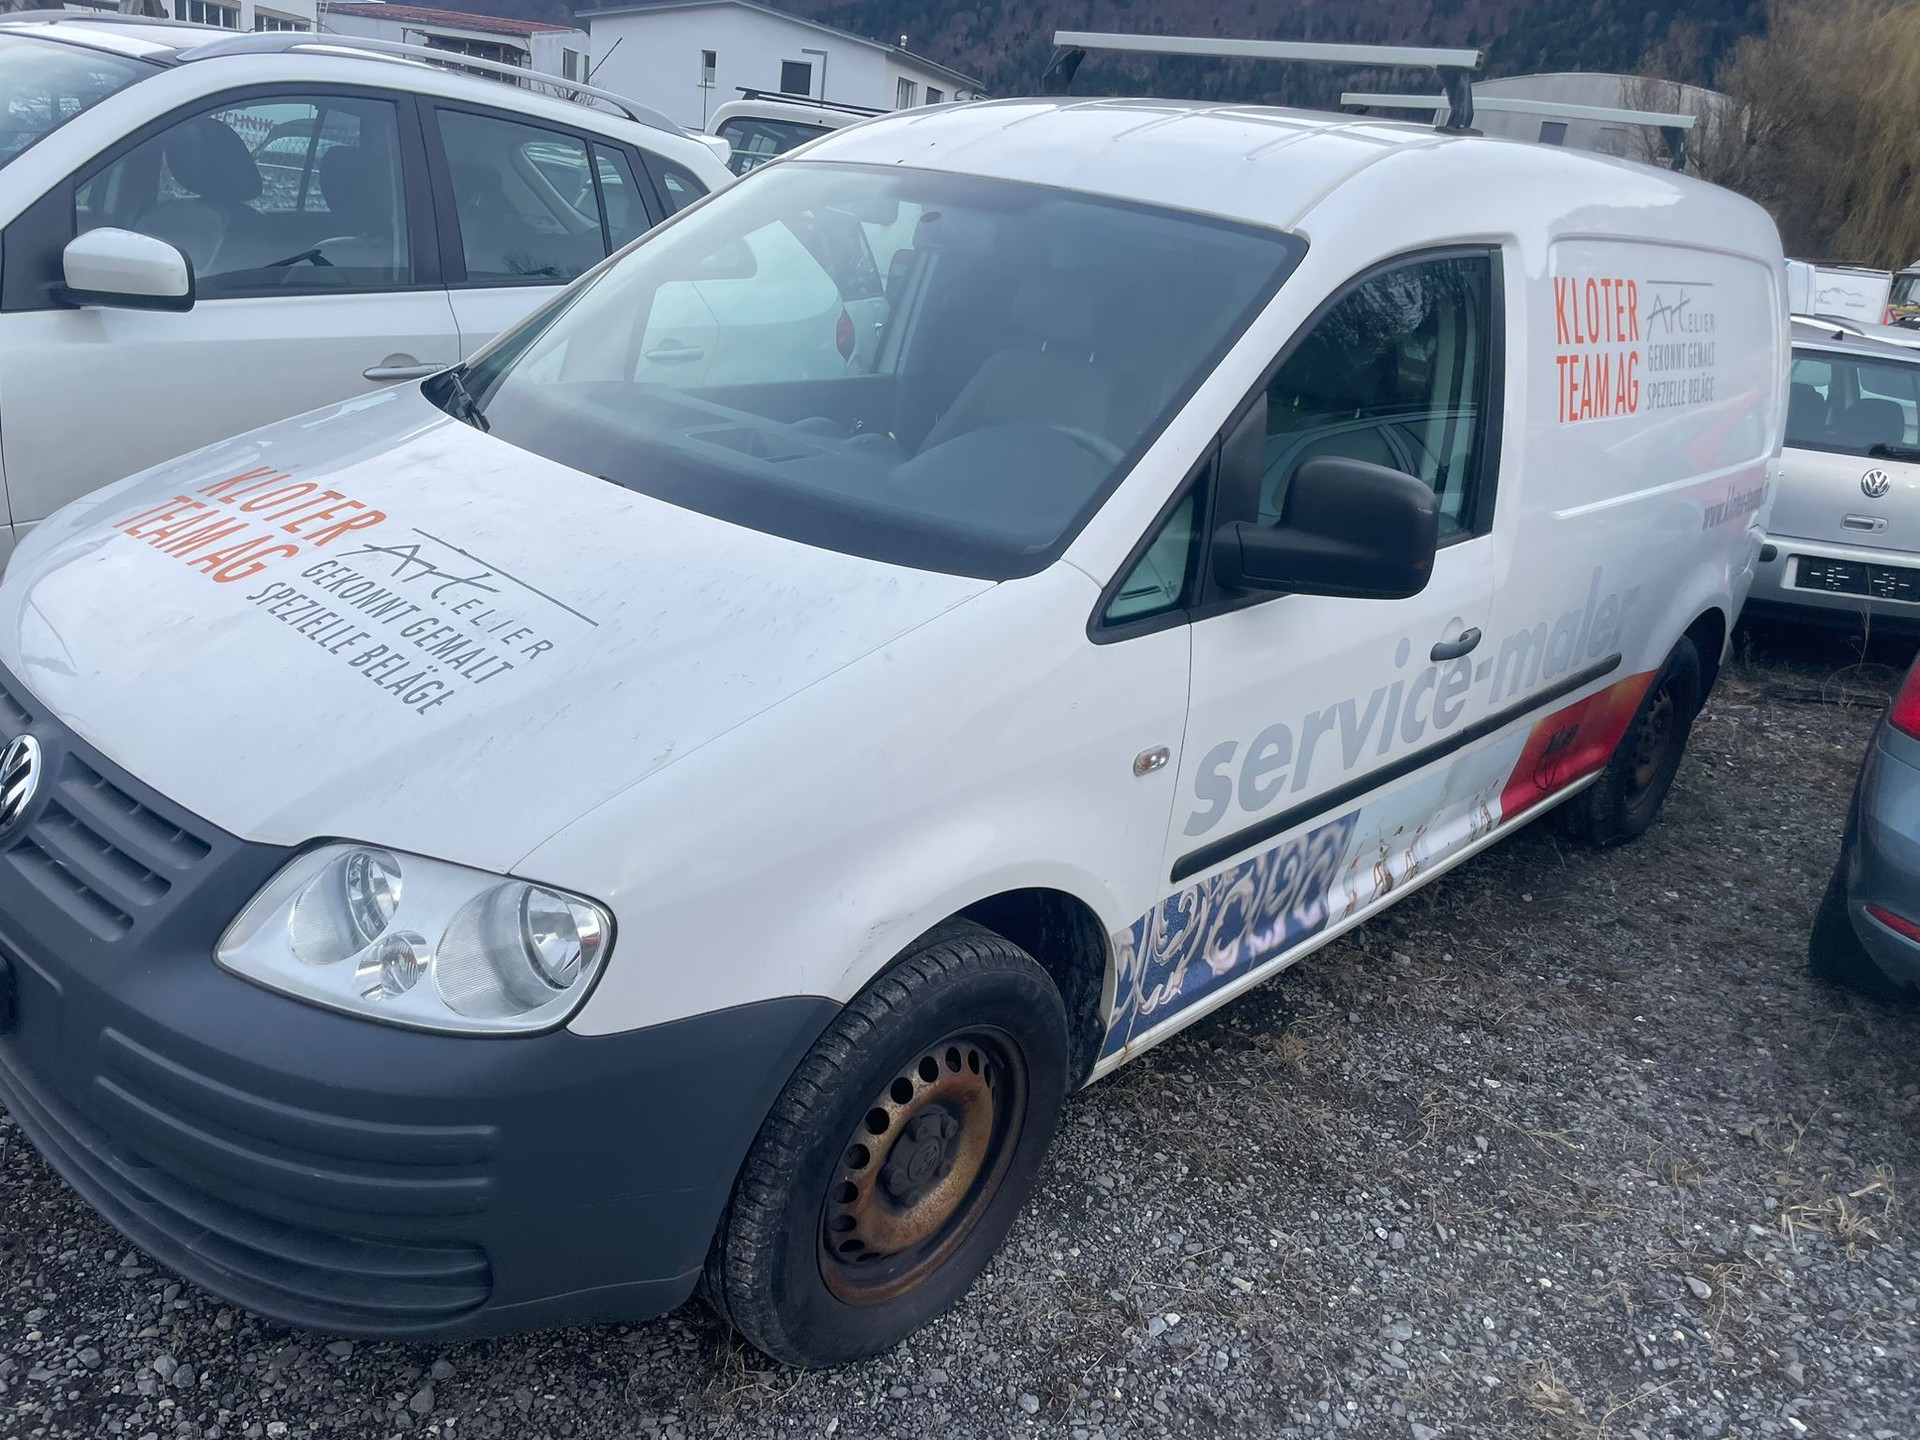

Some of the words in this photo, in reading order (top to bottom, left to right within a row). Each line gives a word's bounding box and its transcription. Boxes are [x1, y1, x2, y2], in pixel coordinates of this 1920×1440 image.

[1554, 277, 1639, 345] KLOTER
[1556, 352, 1610, 423] TEAM
[1614, 350, 1639, 415] AG
[1647, 380, 1686, 410] SPEZIELLE
[1688, 372, 1715, 404] BELÄGE
[1648, 343, 1686, 372] GEKONNT
[1688, 342, 1716, 368] GEMALT
[113, 495, 250, 558] TEAM
[186, 534, 299, 583] AG
[197, 466, 387, 547] KLOTER
[247, 582, 371, 655] SPEZIELLE
[347, 643, 455, 716] BELÄGE
[300, 560, 421, 625] GEKONNT
[399, 617, 514, 684] GEMALT
[1184, 566, 1640, 837] service-maler
